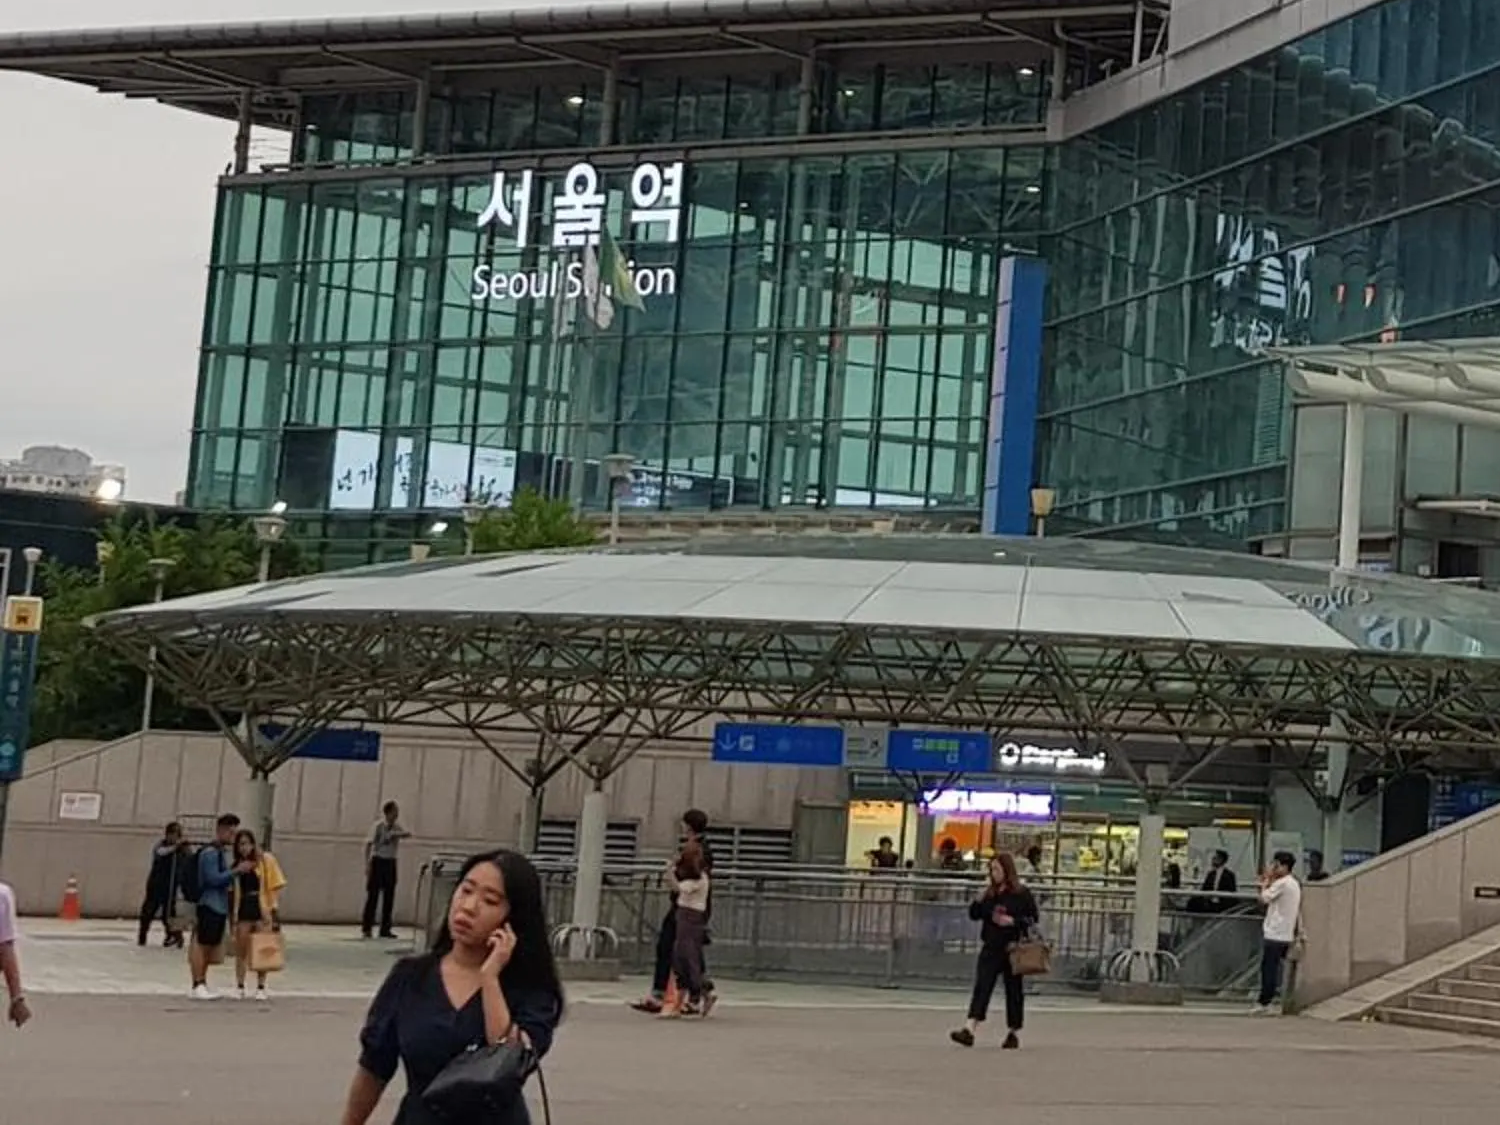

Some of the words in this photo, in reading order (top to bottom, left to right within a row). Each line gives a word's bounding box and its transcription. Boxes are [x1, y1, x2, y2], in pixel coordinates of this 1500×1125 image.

[476, 161, 684, 248] 서울역
[471, 260, 557, 301] Seoul
[566, 259, 676, 299] Sion
